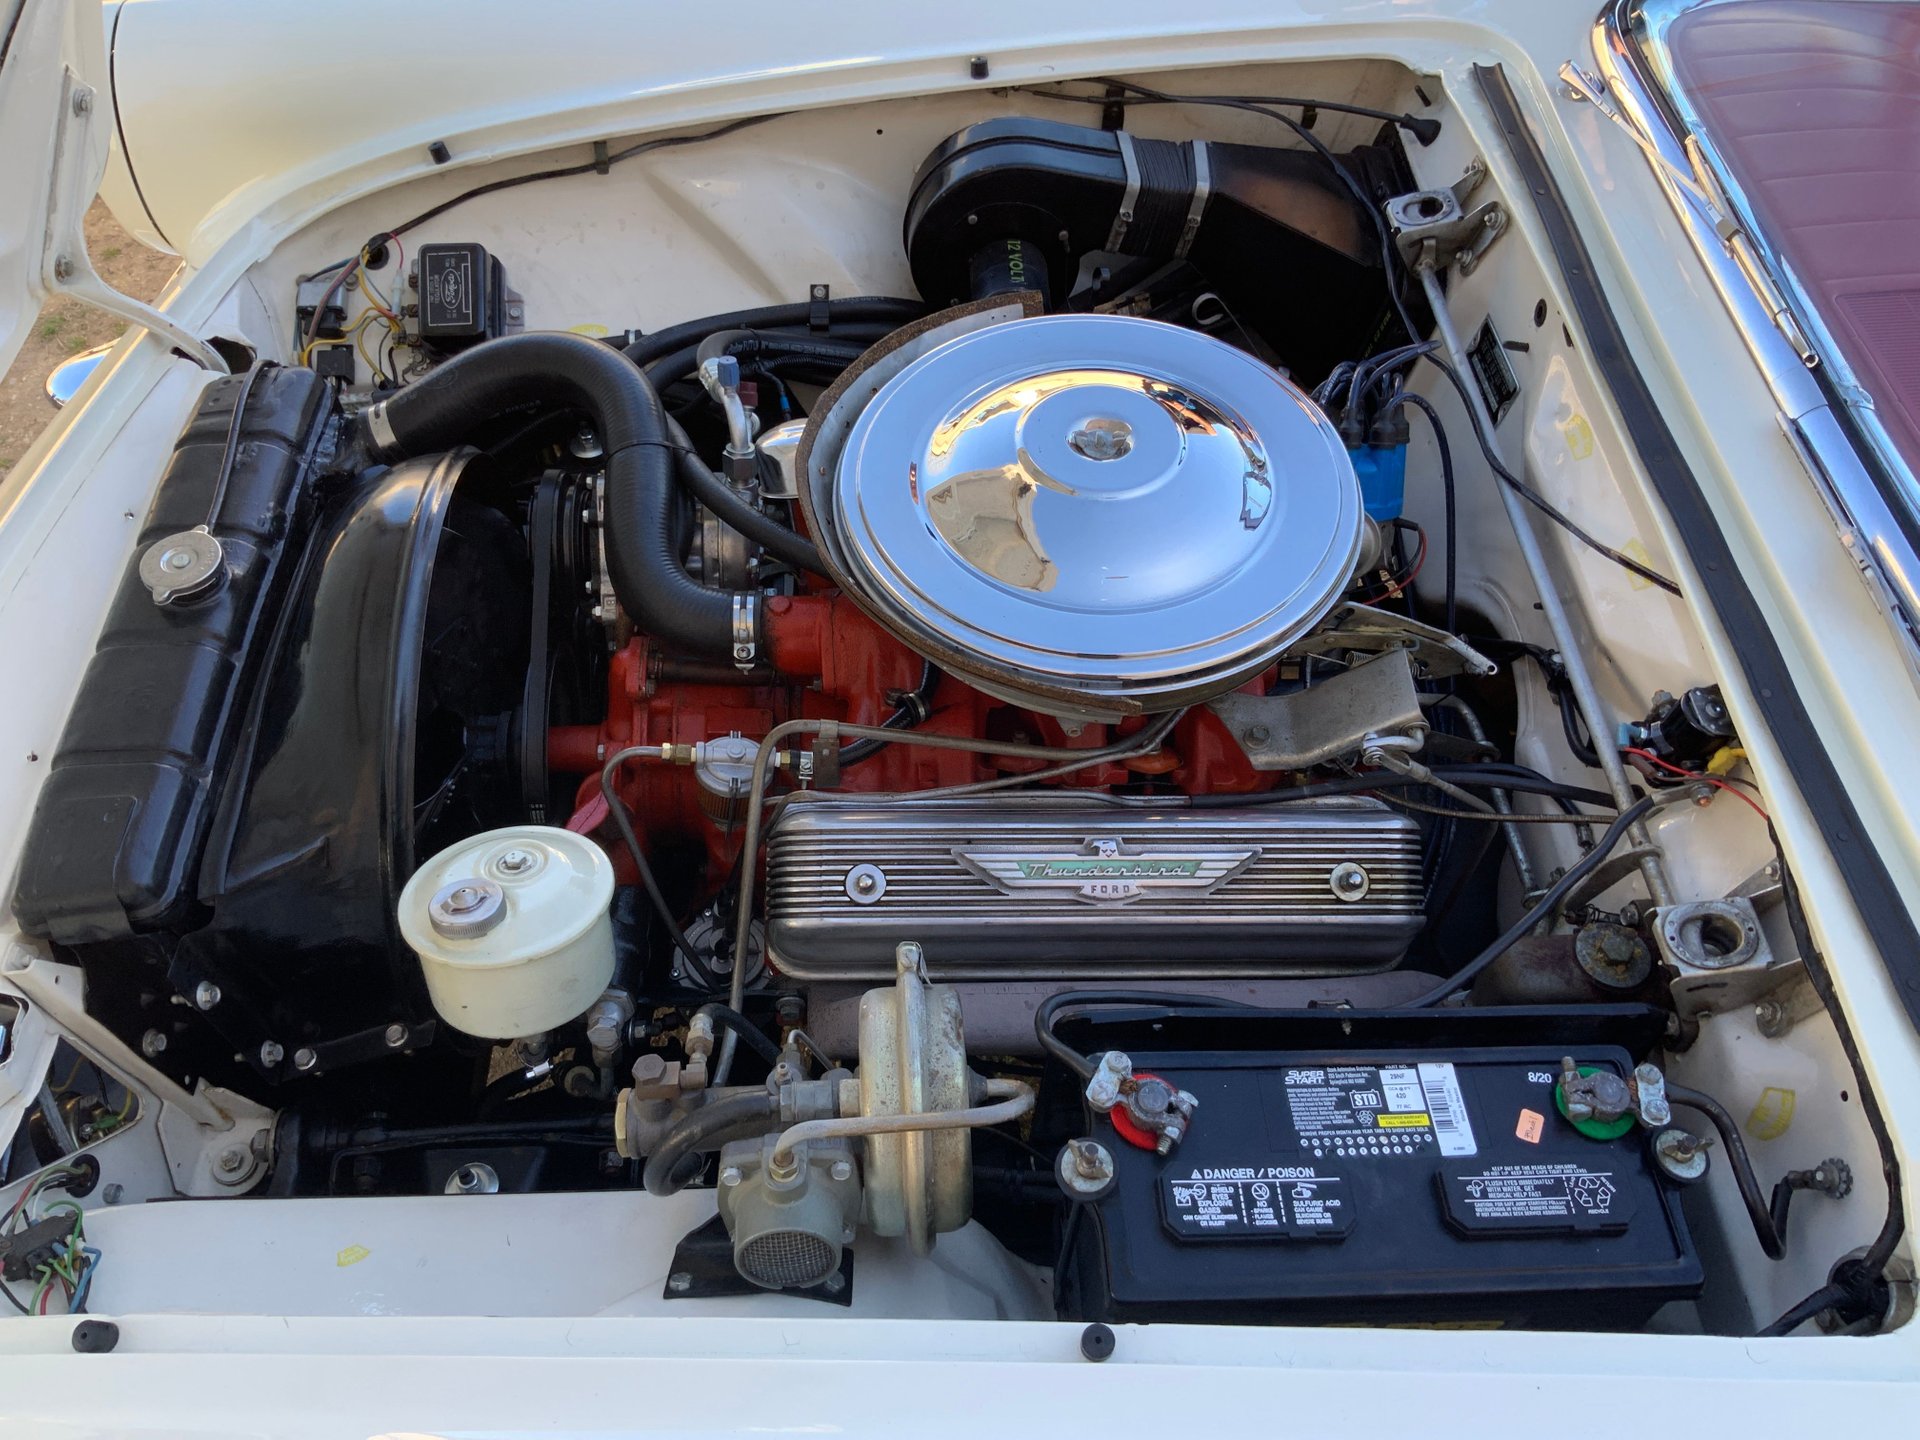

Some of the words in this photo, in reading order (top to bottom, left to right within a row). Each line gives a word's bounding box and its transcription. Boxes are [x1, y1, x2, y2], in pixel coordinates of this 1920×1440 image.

[1007, 240, 1021, 250] 12
[1027, 863, 1190, 877] Thunderbird
[1090, 885, 1130, 894] FORD
[1288, 1070, 1324, 1078] SUPER
[1527, 1071, 1552, 1083] 8/20
[1284, 1076, 1324, 1084] START
[1354, 1093, 1377, 1106] STD
[1203, 1168, 1255, 1179] DANGER
[1257, 1168, 1264, 1178] /
[1267, 1167, 1315, 1178] POISON
